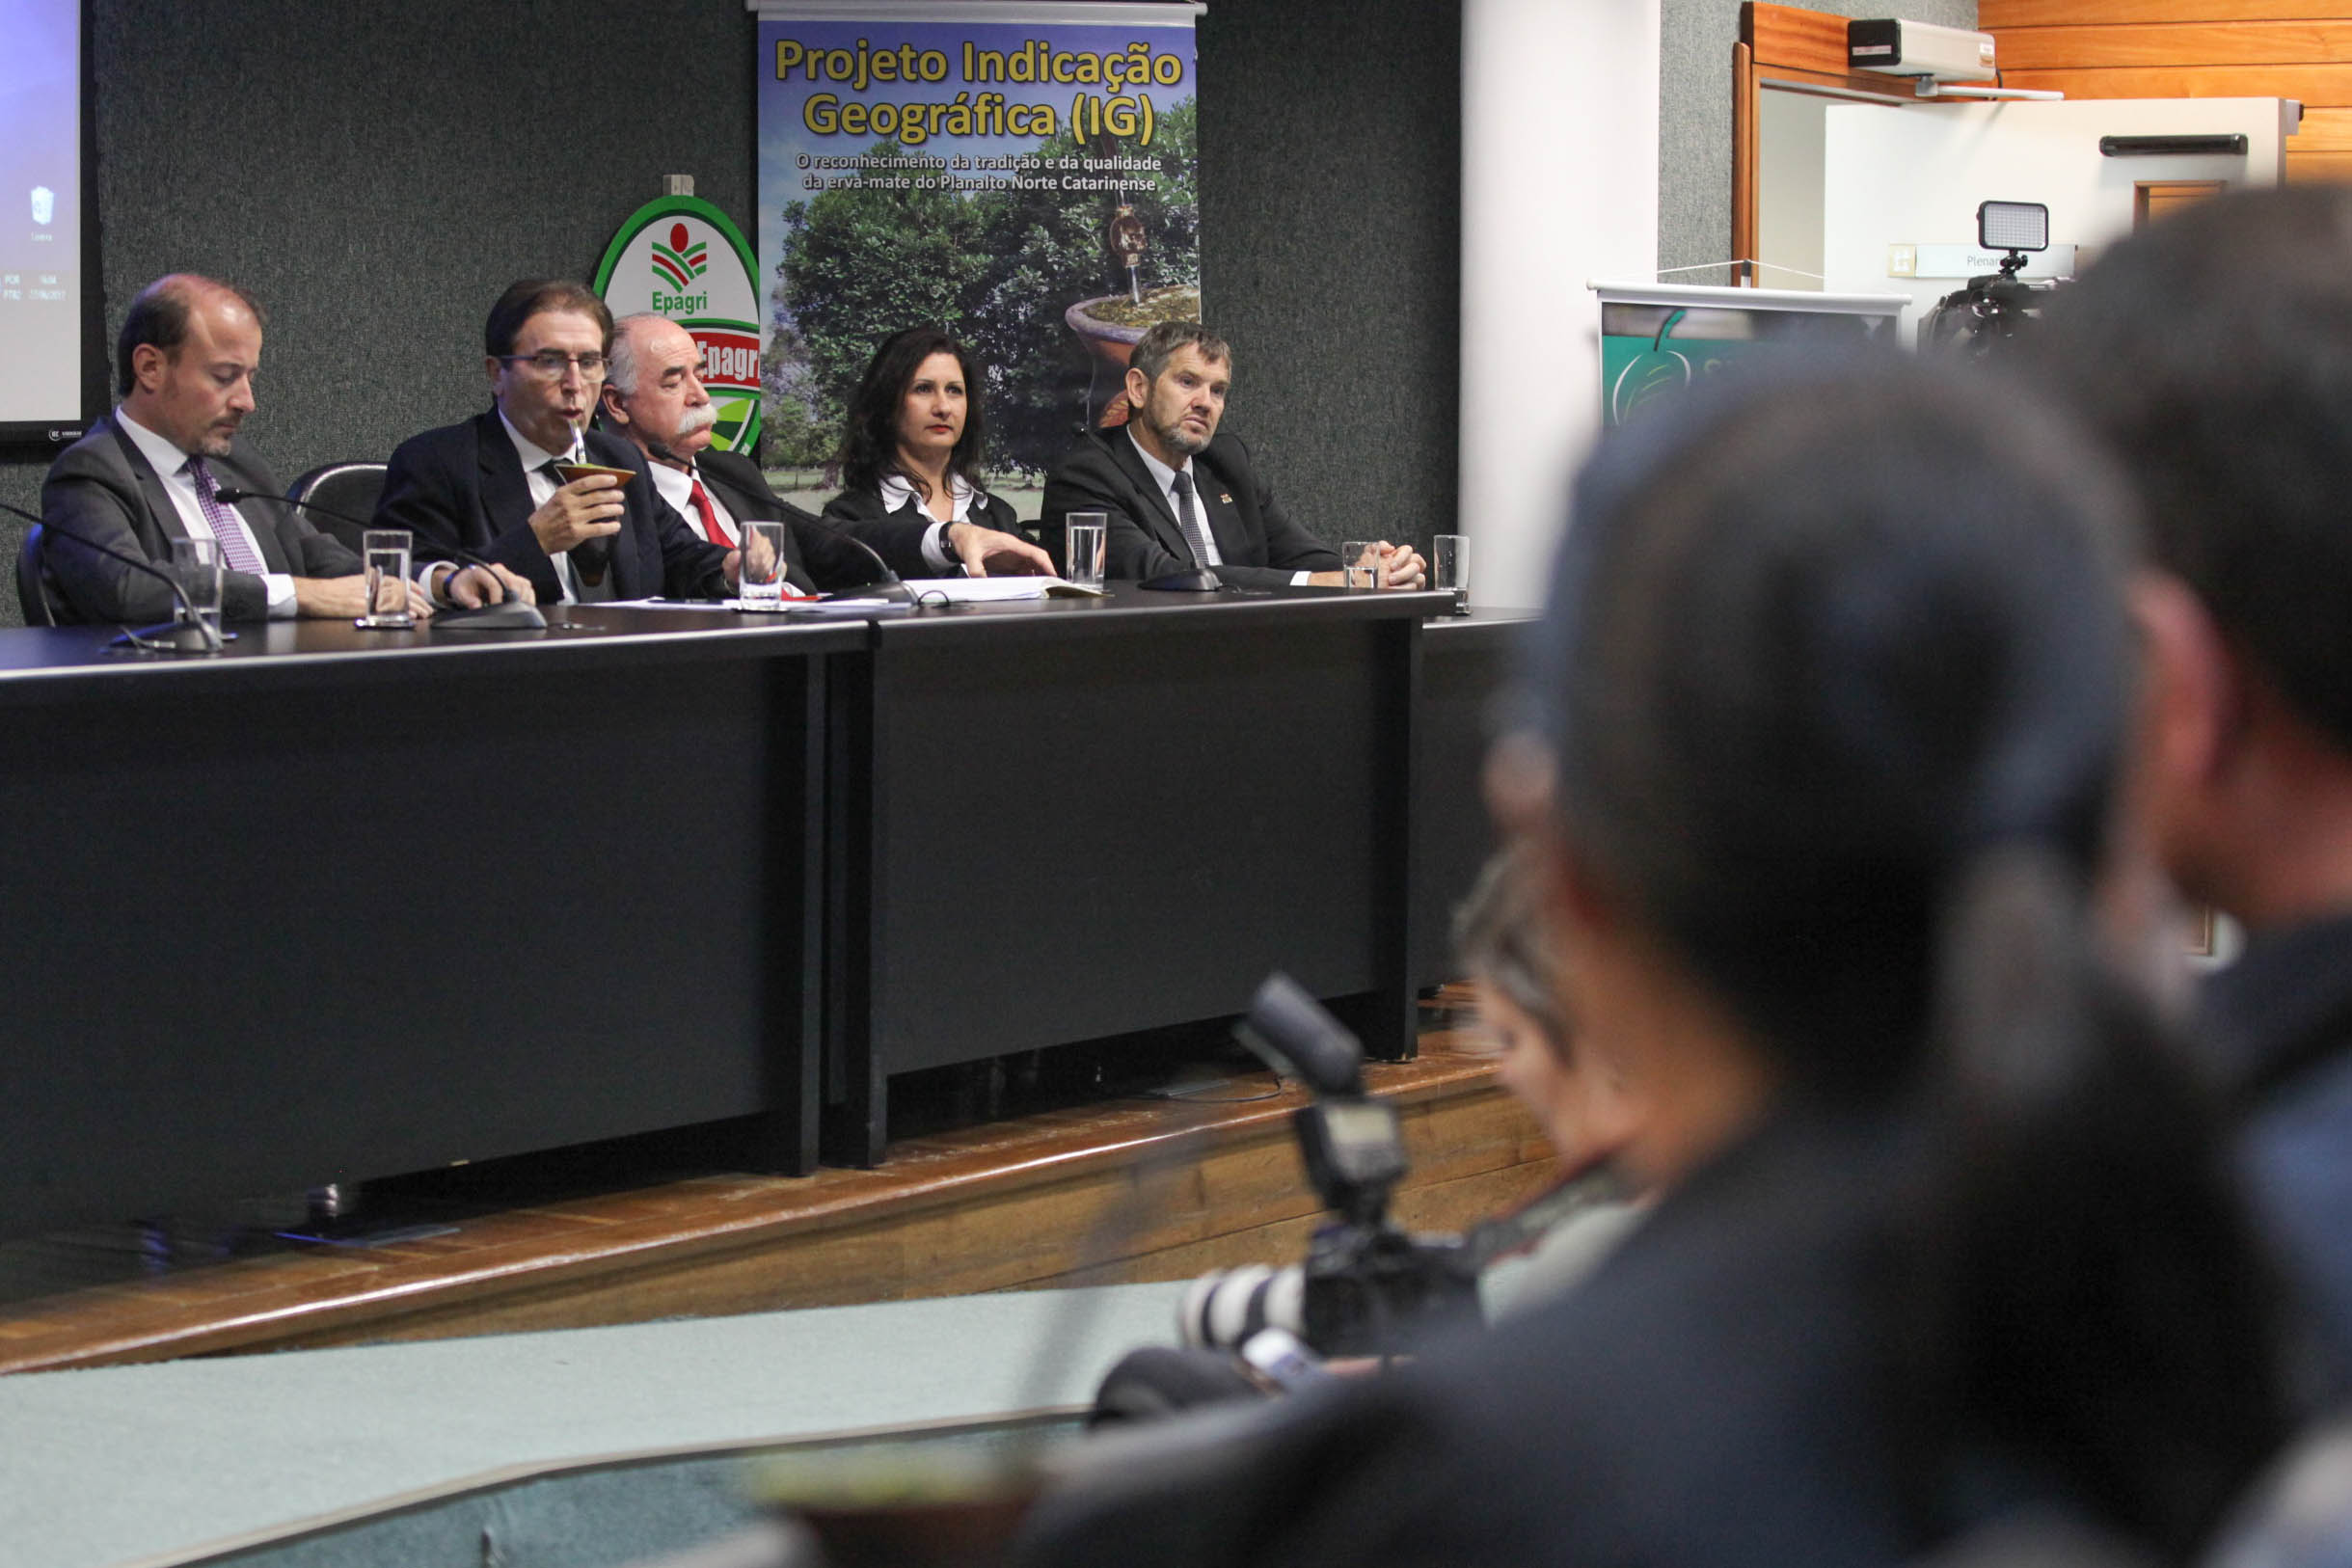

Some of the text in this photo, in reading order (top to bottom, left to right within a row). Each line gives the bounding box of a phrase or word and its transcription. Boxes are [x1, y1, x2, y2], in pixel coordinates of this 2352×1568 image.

[775, 38, 1182, 93] Projeto Indicação
[803, 92, 1154, 146] Geográfica (IG)
[797, 153, 1162, 175] O reconhecimento da tradição e da qualidade
[802, 175, 1156, 192] da erva-mate do Planalto Norte Catarinense
[652, 290, 708, 315] Epagri
[697, 340, 760, 382] Epagr
